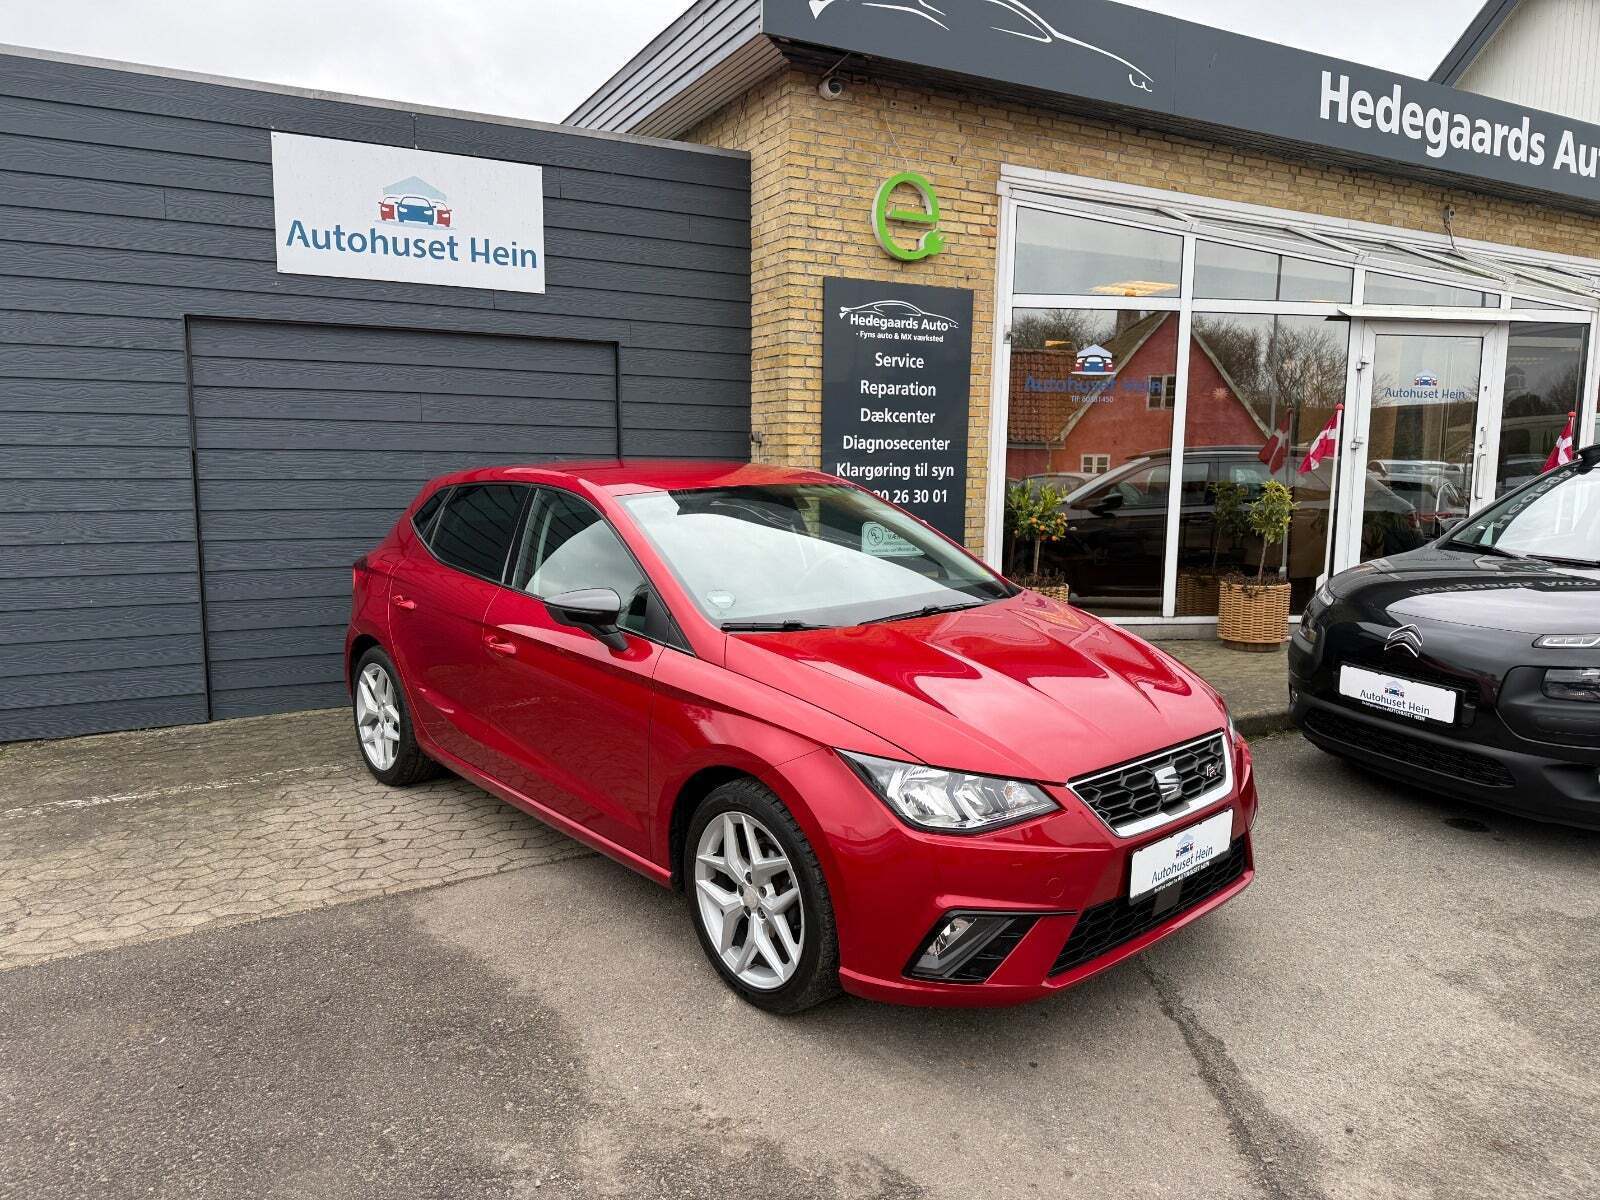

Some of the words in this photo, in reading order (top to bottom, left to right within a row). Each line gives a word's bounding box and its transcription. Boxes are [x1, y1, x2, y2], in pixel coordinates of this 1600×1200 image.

[1320, 70, 1546, 166] Hedegaards
[1552, 130, 1600, 178] Au
[286, 219, 459, 262] Autohuset
[470, 237, 537, 269] Hein
[850, 314, 918, 330] Hedegaards
[921, 318, 949, 332] Auto
[859, 331, 876, 339] Fyns
[875, 353, 924, 369] Service
[860, 380, 937, 400] Reparation
[1384, 388, 1438, 399] Autohuset
[1442, 389, 1465, 399] Hein
[860, 408, 936, 424] Dækcenter
[843, 435, 950, 453] Diagnosecenter
[836, 463, 908, 480] Klargøring
[915, 465, 928, 477] til
[932, 467, 954, 480] syn
[893, 490, 909, 504] 26
[913, 490, 929, 503] 30
[933, 490, 947, 503] 01
[1360, 689, 1406, 709] Autohuset
[1408, 701, 1430, 716] Hein
[1152, 852, 1194, 884] Autohuset
[1195, 845, 1213, 861] Hein
